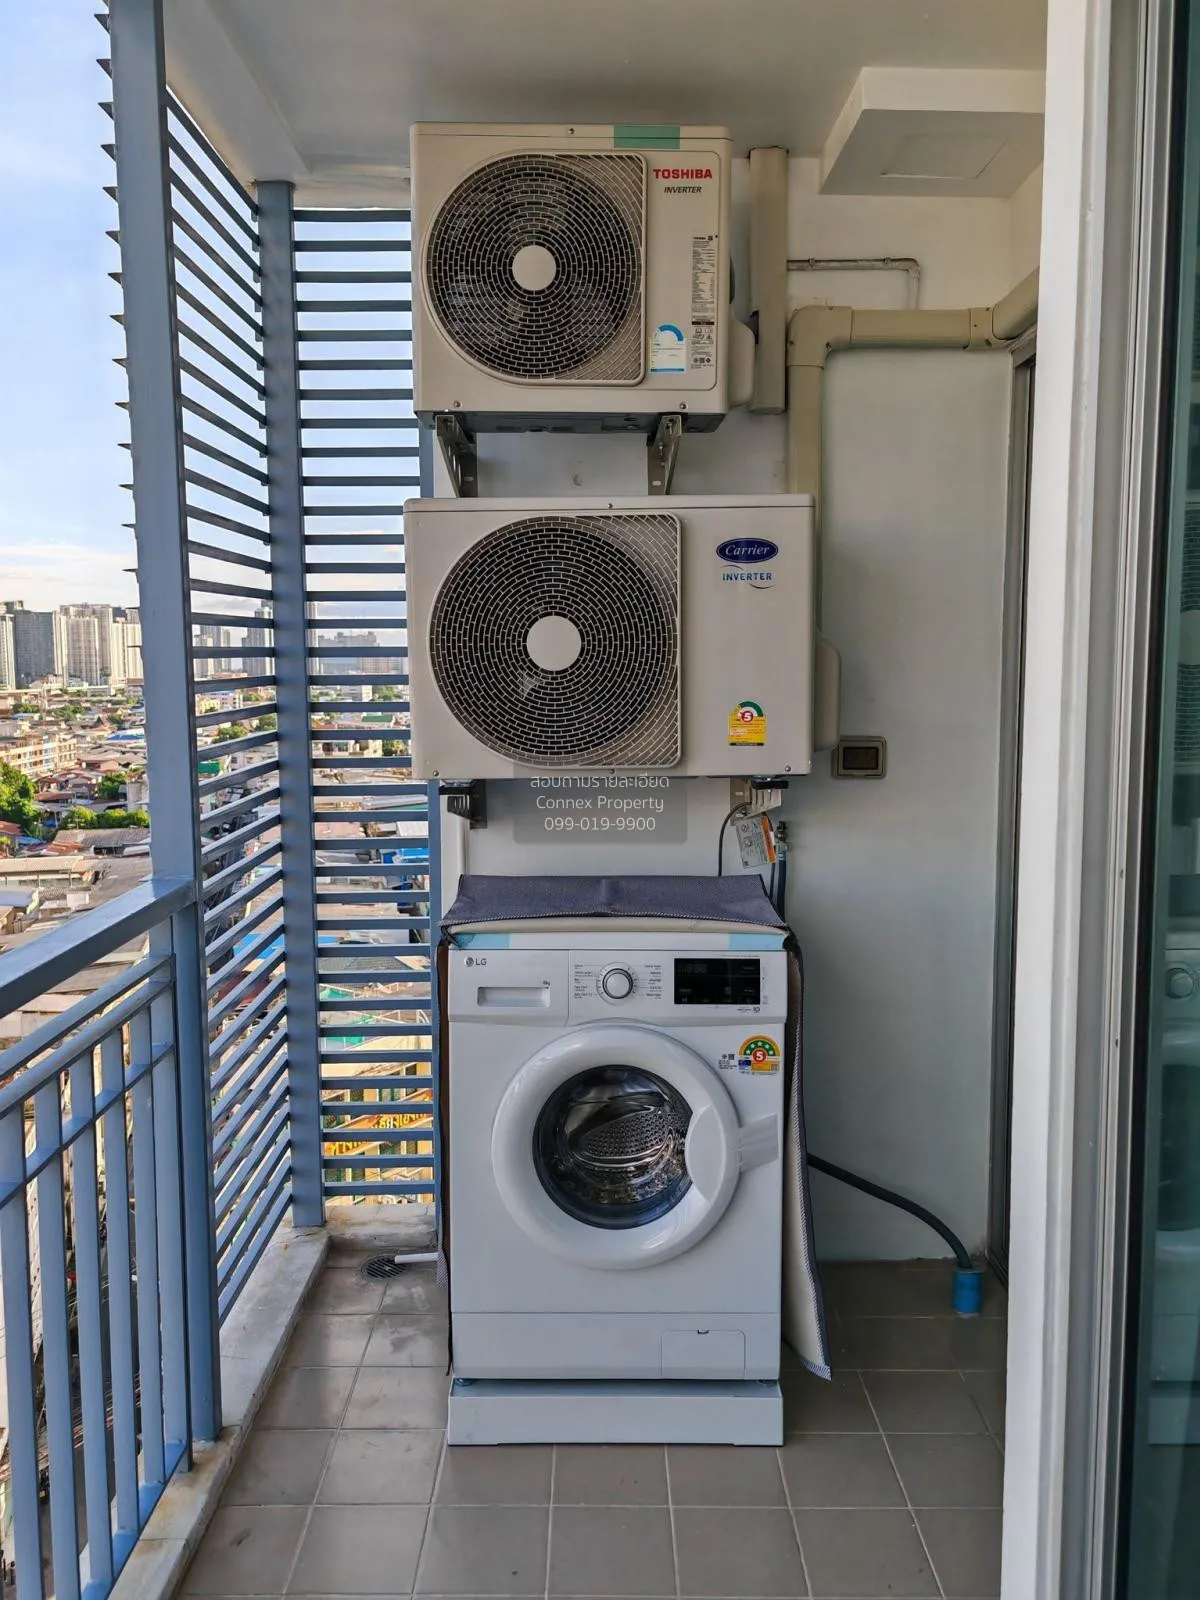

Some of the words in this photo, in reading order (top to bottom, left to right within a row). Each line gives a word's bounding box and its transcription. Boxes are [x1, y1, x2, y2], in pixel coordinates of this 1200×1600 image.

[653, 168, 712, 180] TOSHIBA
[664, 186, 702, 194] INVERTER
[725, 544, 770, 556] Carrier
[722, 572, 772, 581] INVERTER
[743, 711, 752, 722] 5
[756, 1050, 764, 1061] 5
